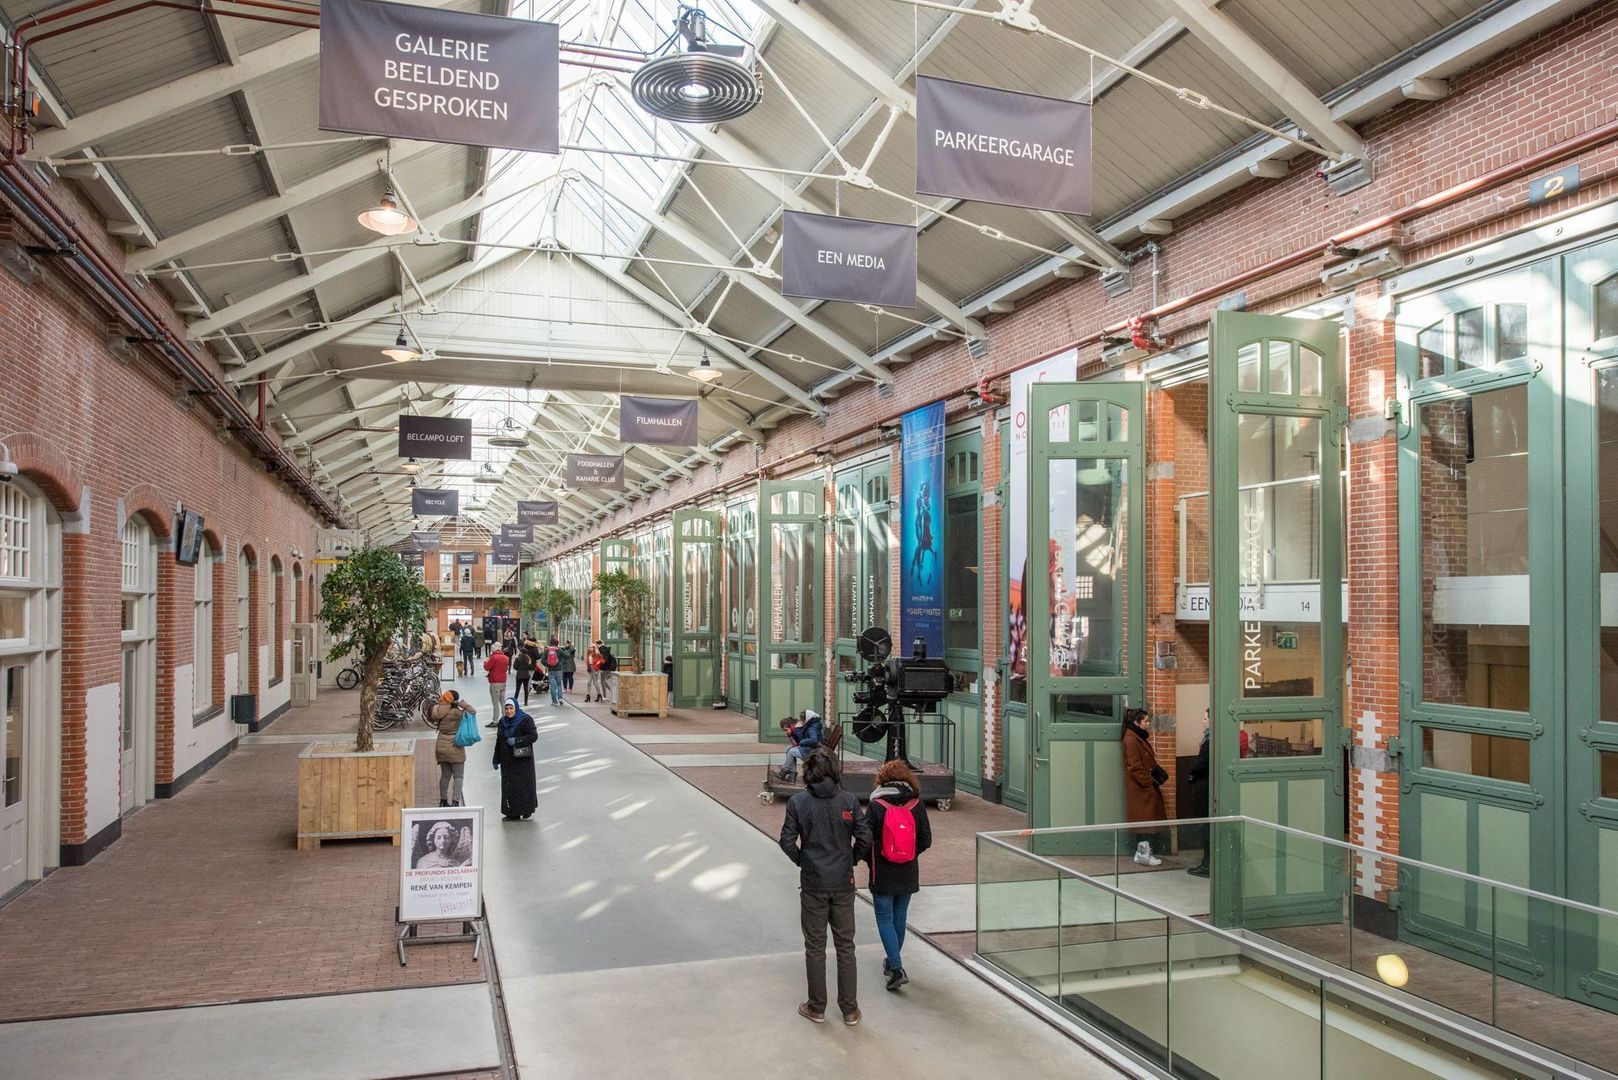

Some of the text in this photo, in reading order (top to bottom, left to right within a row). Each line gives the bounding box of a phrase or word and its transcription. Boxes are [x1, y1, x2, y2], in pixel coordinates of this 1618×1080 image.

[395, 33, 489, 62] GALERIE
[384, 60, 500, 91] BEELDEND
[374, 87, 508, 121] GESPROKEN
[934, 129, 1074, 167] PARKEERGARAGE
[1544, 176, 1563, 198] 2
[817, 250, 886, 271] EEN MEDIA
[636, 416, 683, 427] FILMHALLEN
[406, 432, 465, 443] BELCAMPO LOFT
[577, 460, 615, 468] FOODHALLEN
[1245, 507, 1262, 689] PARKERGARAGE
[1301, 601, 1310, 611] 14
[773, 583, 783, 640] FILMHALLEN
[444, 882, 473, 890] KEMPEN
